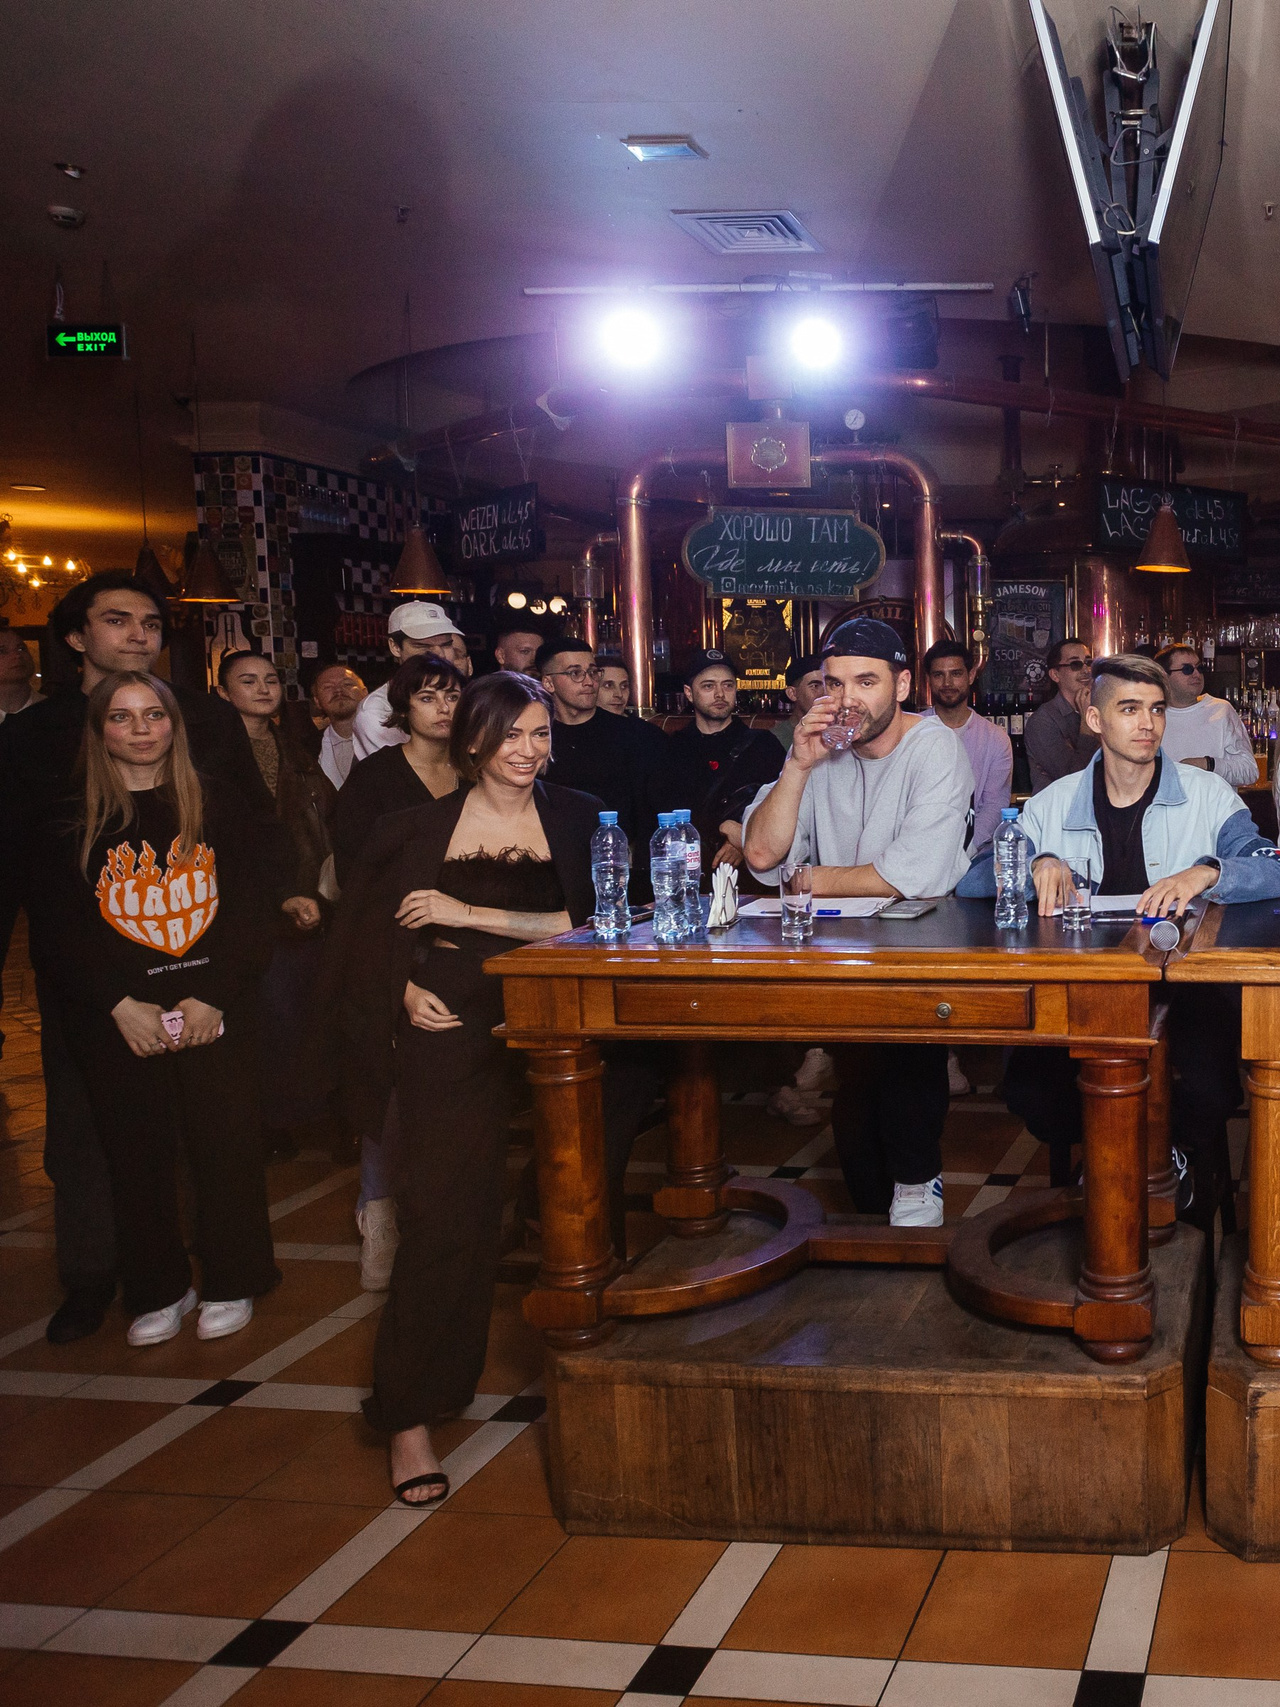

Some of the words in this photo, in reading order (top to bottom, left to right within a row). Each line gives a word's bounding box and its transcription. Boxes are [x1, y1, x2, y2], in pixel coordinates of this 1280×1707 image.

[76, 332, 117, 343] ВЫХОД
[76, 343, 106, 351] EXIT
[459, 504, 499, 532] WEIZEN
[718, 515, 792, 543] ХОРОШО
[806, 516, 849, 544] ТАМ
[461, 529, 500, 559] DARK
[692, 545, 746, 573] Где
[756, 557, 801, 574] мы
[996, 584, 1047, 598] JAMESON
[169, 963, 182, 971] GET
[183, 956, 210, 968] BURNED
